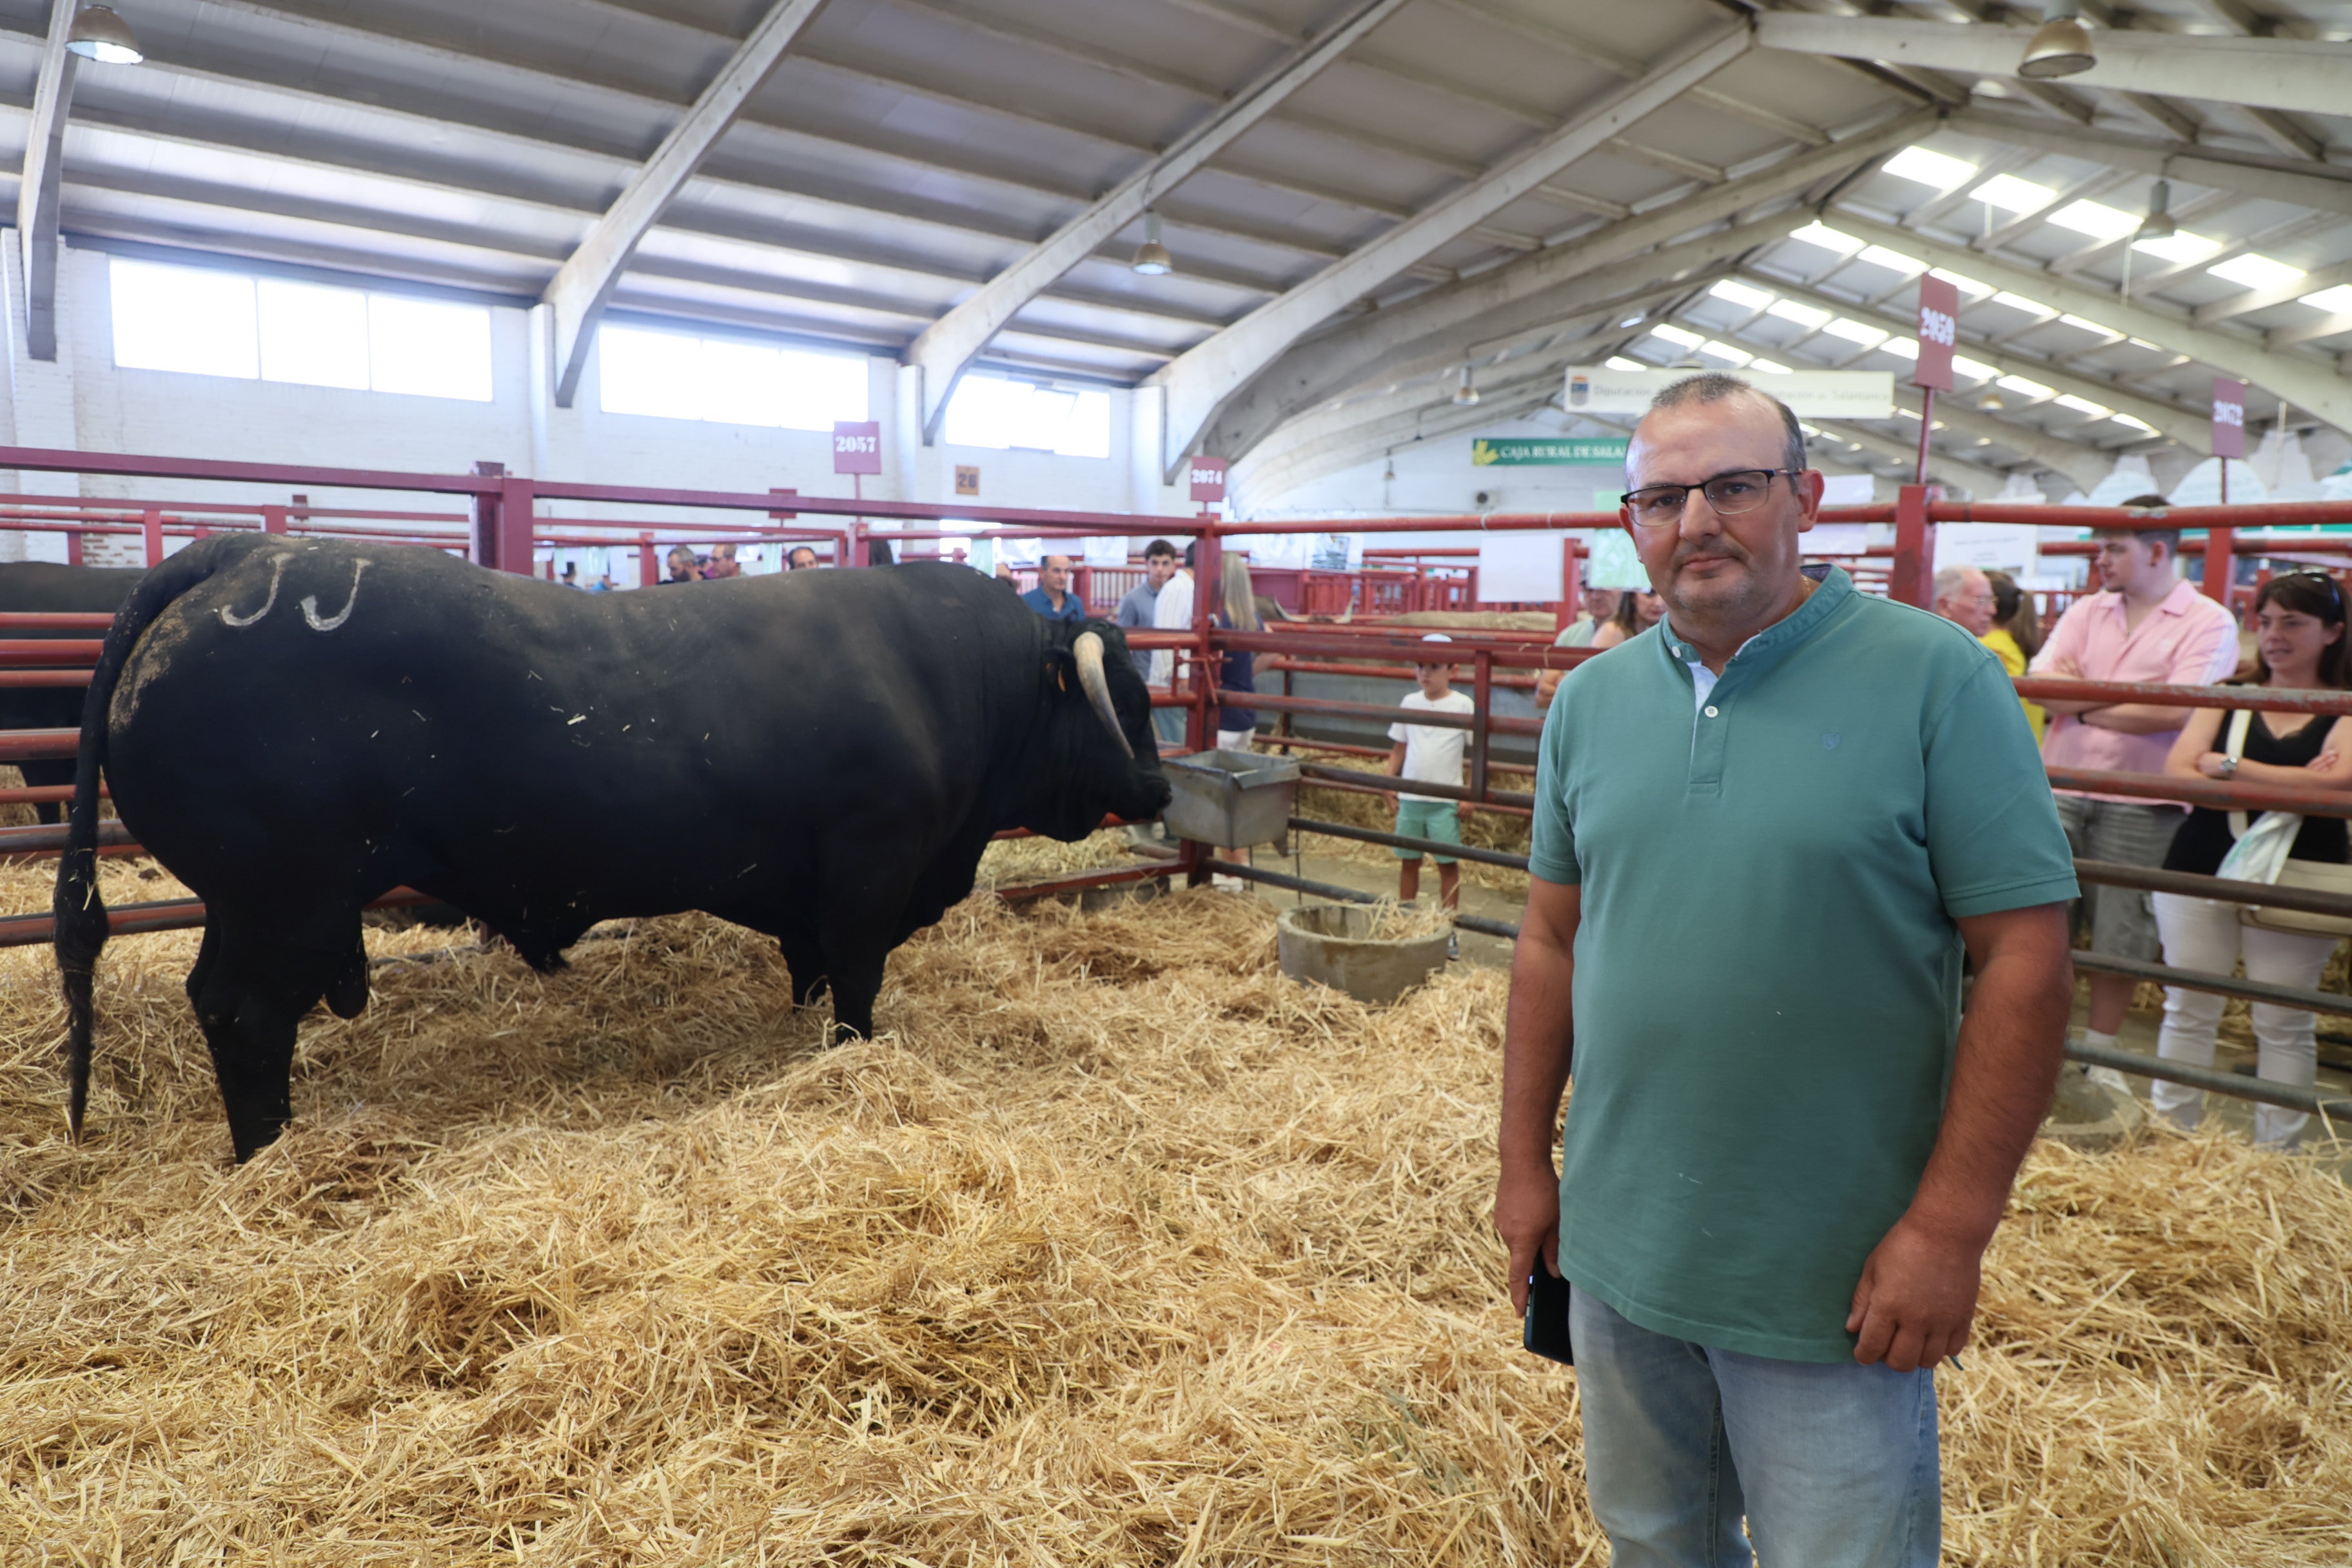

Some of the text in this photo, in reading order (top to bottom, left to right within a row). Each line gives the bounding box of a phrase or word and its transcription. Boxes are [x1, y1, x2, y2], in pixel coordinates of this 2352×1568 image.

[835, 435, 877, 453] 2057
[1500, 446, 1530, 460] CAJA
[1532, 446, 1571, 458] RURAL
[1573, 446, 1590, 458] DE
[1191, 469, 1223, 485] 2074
